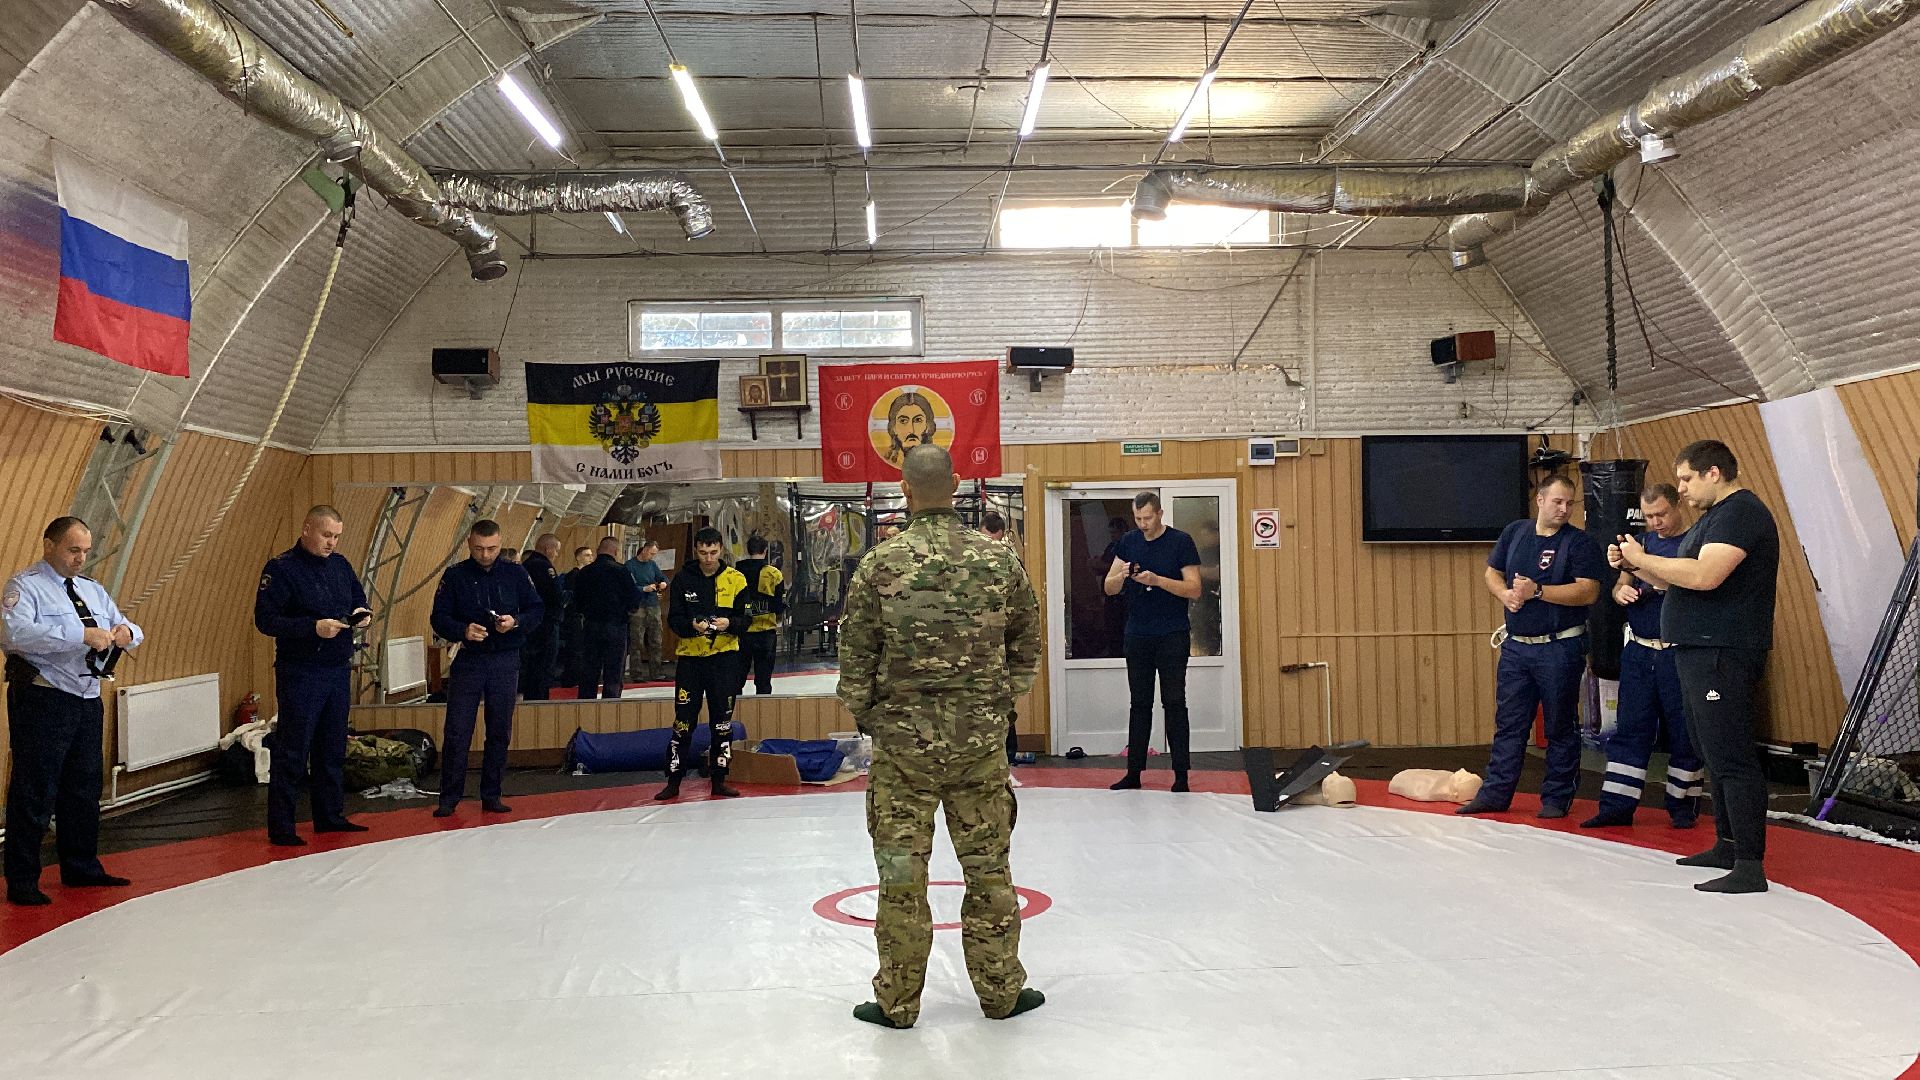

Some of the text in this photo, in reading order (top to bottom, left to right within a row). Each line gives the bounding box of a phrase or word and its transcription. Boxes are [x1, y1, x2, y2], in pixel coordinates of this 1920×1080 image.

[572, 366, 675, 389] МЫ РУССКИЕ
[576, 461, 673, 480] С НАМИ БОГЪ
